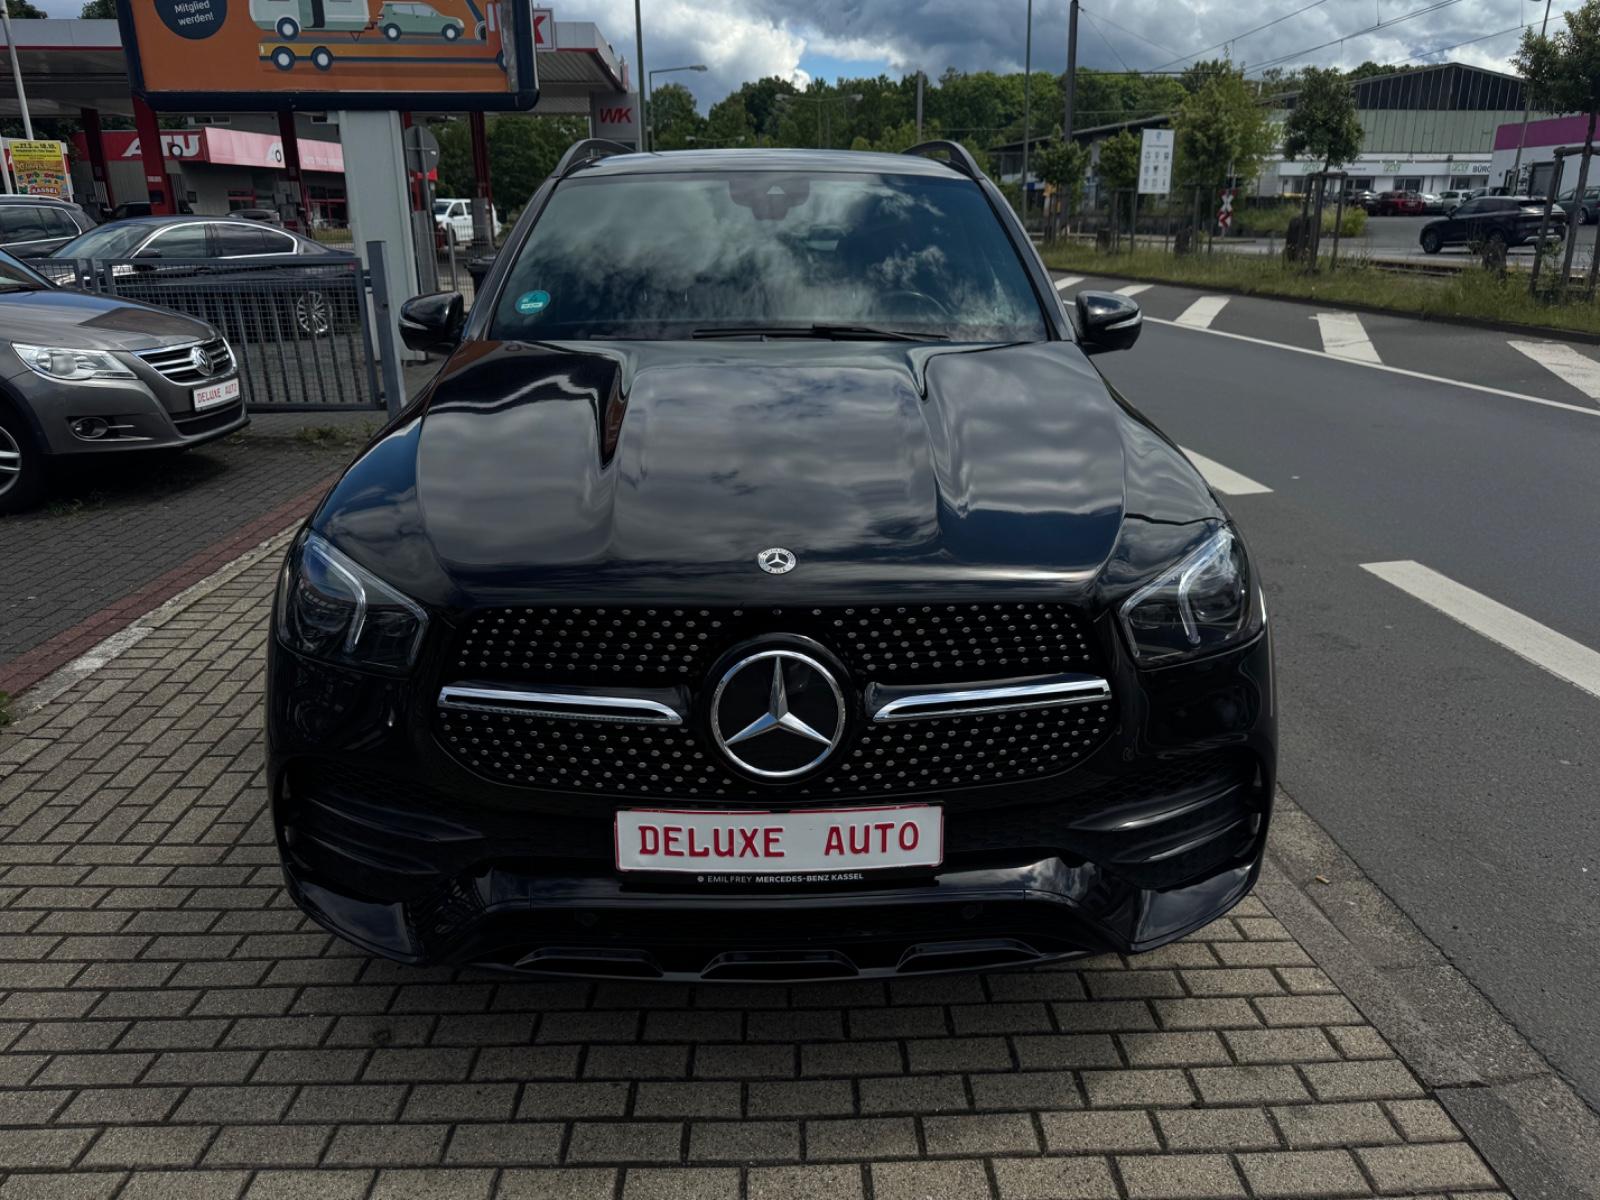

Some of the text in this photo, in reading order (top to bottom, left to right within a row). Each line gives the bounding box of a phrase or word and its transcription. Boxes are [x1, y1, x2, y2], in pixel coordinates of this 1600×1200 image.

[174, 0, 210, 13] Mitglied
[178, 12, 214, 26] werden!
[600, 108, 632, 124] WK
[196, 387, 221, 404] DELUXE
[638, 821, 920, 858] DELUXE AUTO
[707, 873, 864, 883] EMIL FREY MERCEDES-BENZ KASSEL
